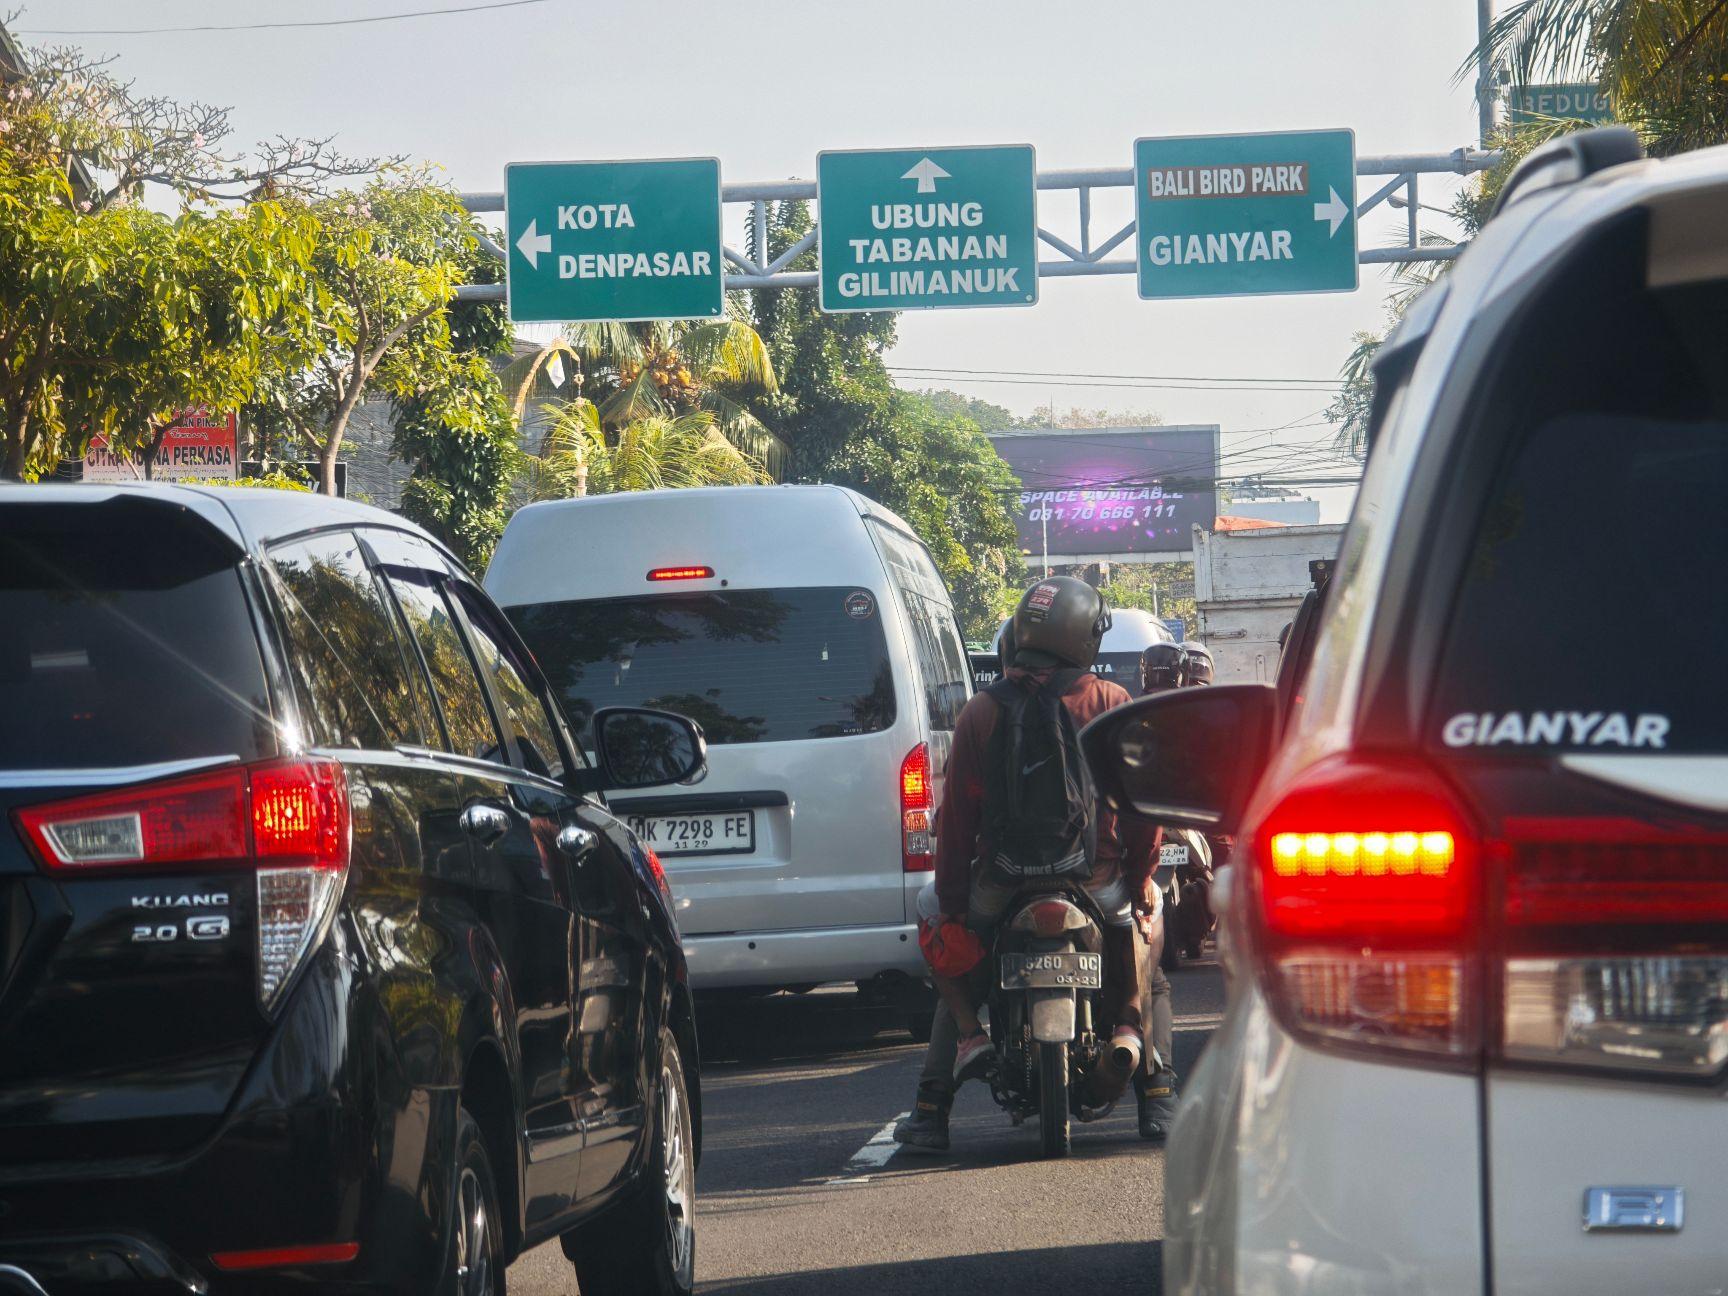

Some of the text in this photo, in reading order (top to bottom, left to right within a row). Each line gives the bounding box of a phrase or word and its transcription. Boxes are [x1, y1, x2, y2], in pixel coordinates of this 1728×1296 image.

[1151, 165, 1304, 197] BALI BIRD PARK
[558, 204, 636, 230] KOTA
[871, 202, 984, 230] UBUNG
[849, 235, 1008, 264] TABANAN
[1149, 230, 1294, 266] GIANYAR
[559, 251, 713, 279] DENPASAR
[837, 267, 1020, 298] GILIMANUK
[87, 447, 124, 467] CITRA
[173, 444, 231, 466] PERKASA
[1020, 490, 1079, 503] SPACE
[1071, 507, 1096, 520] 70
[1100, 506, 1135, 520] 666
[1142, 504, 1176, 518] 111
[1442, 711, 1671, 749] GIANYAR
[666, 819, 714, 841] 7298
[724, 817, 748, 838] FE
